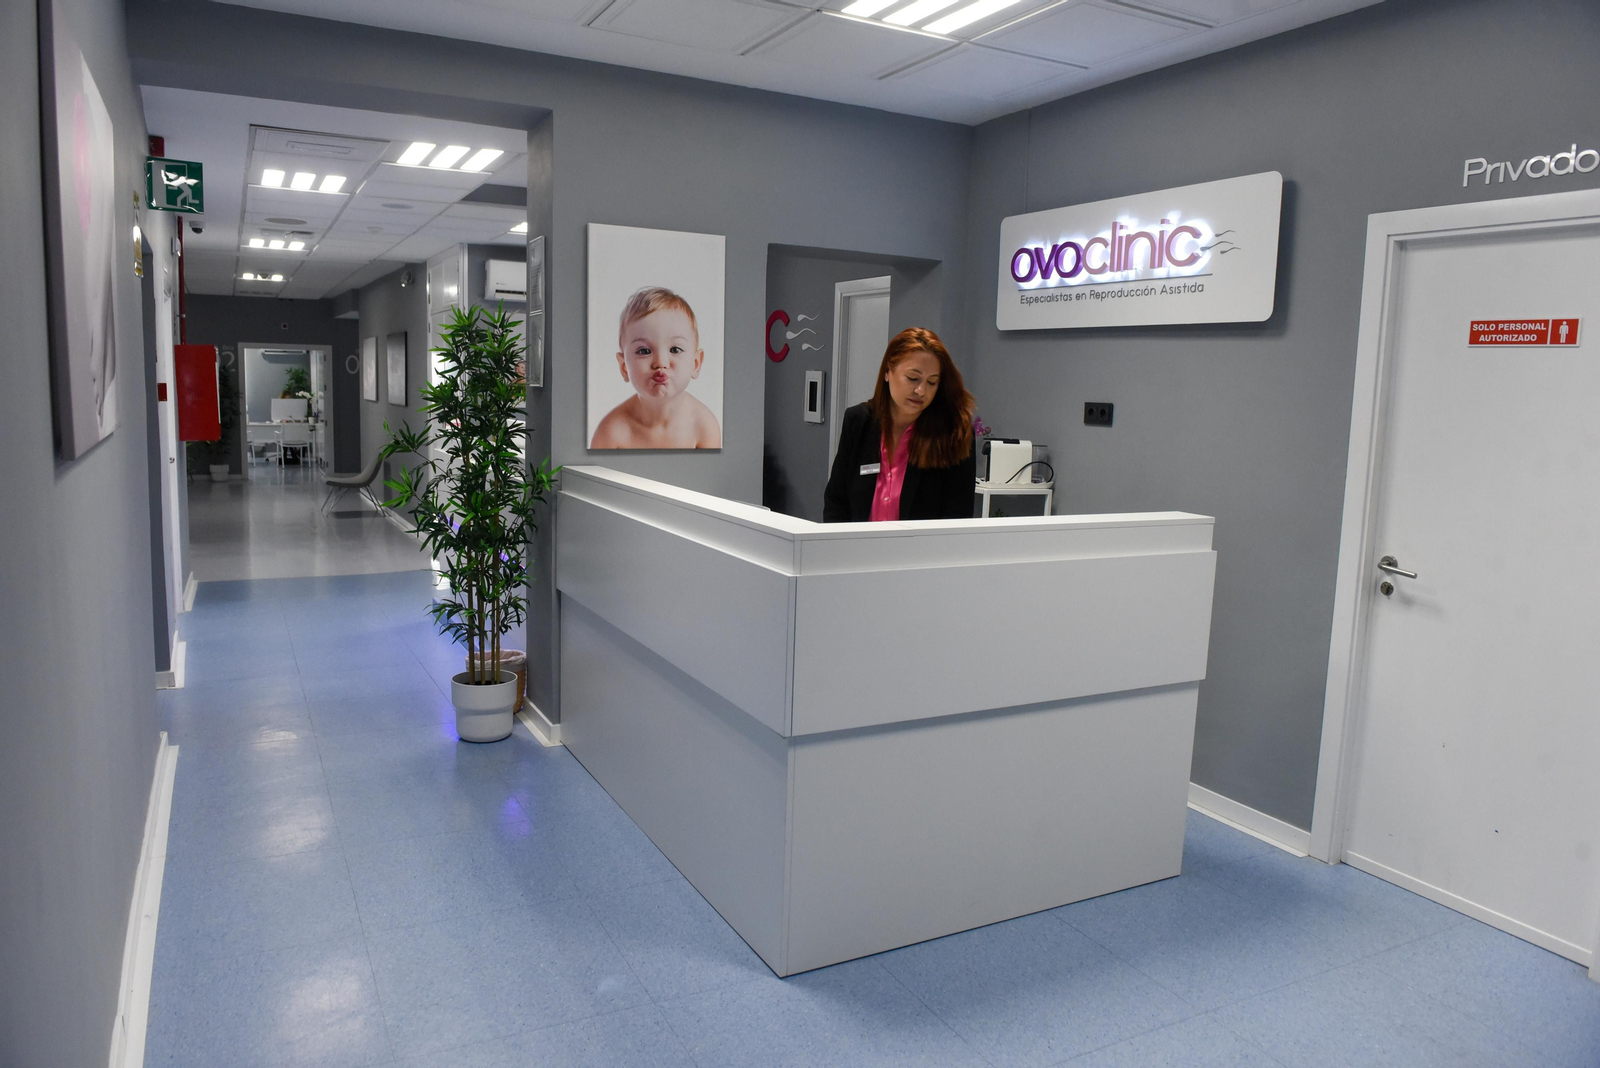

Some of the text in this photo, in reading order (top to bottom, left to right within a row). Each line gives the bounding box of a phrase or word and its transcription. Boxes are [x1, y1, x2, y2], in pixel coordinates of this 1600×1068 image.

[1462, 143, 1600, 188] Privado
[1010, 218, 1203, 284] ovoclinic
[1020, 281, 1204, 306] Especialistas en Reproducción Asistida
[1472, 322, 1547, 331] SOLO PERSONAL
[1478, 334, 1538, 342] AUTORIZADO
